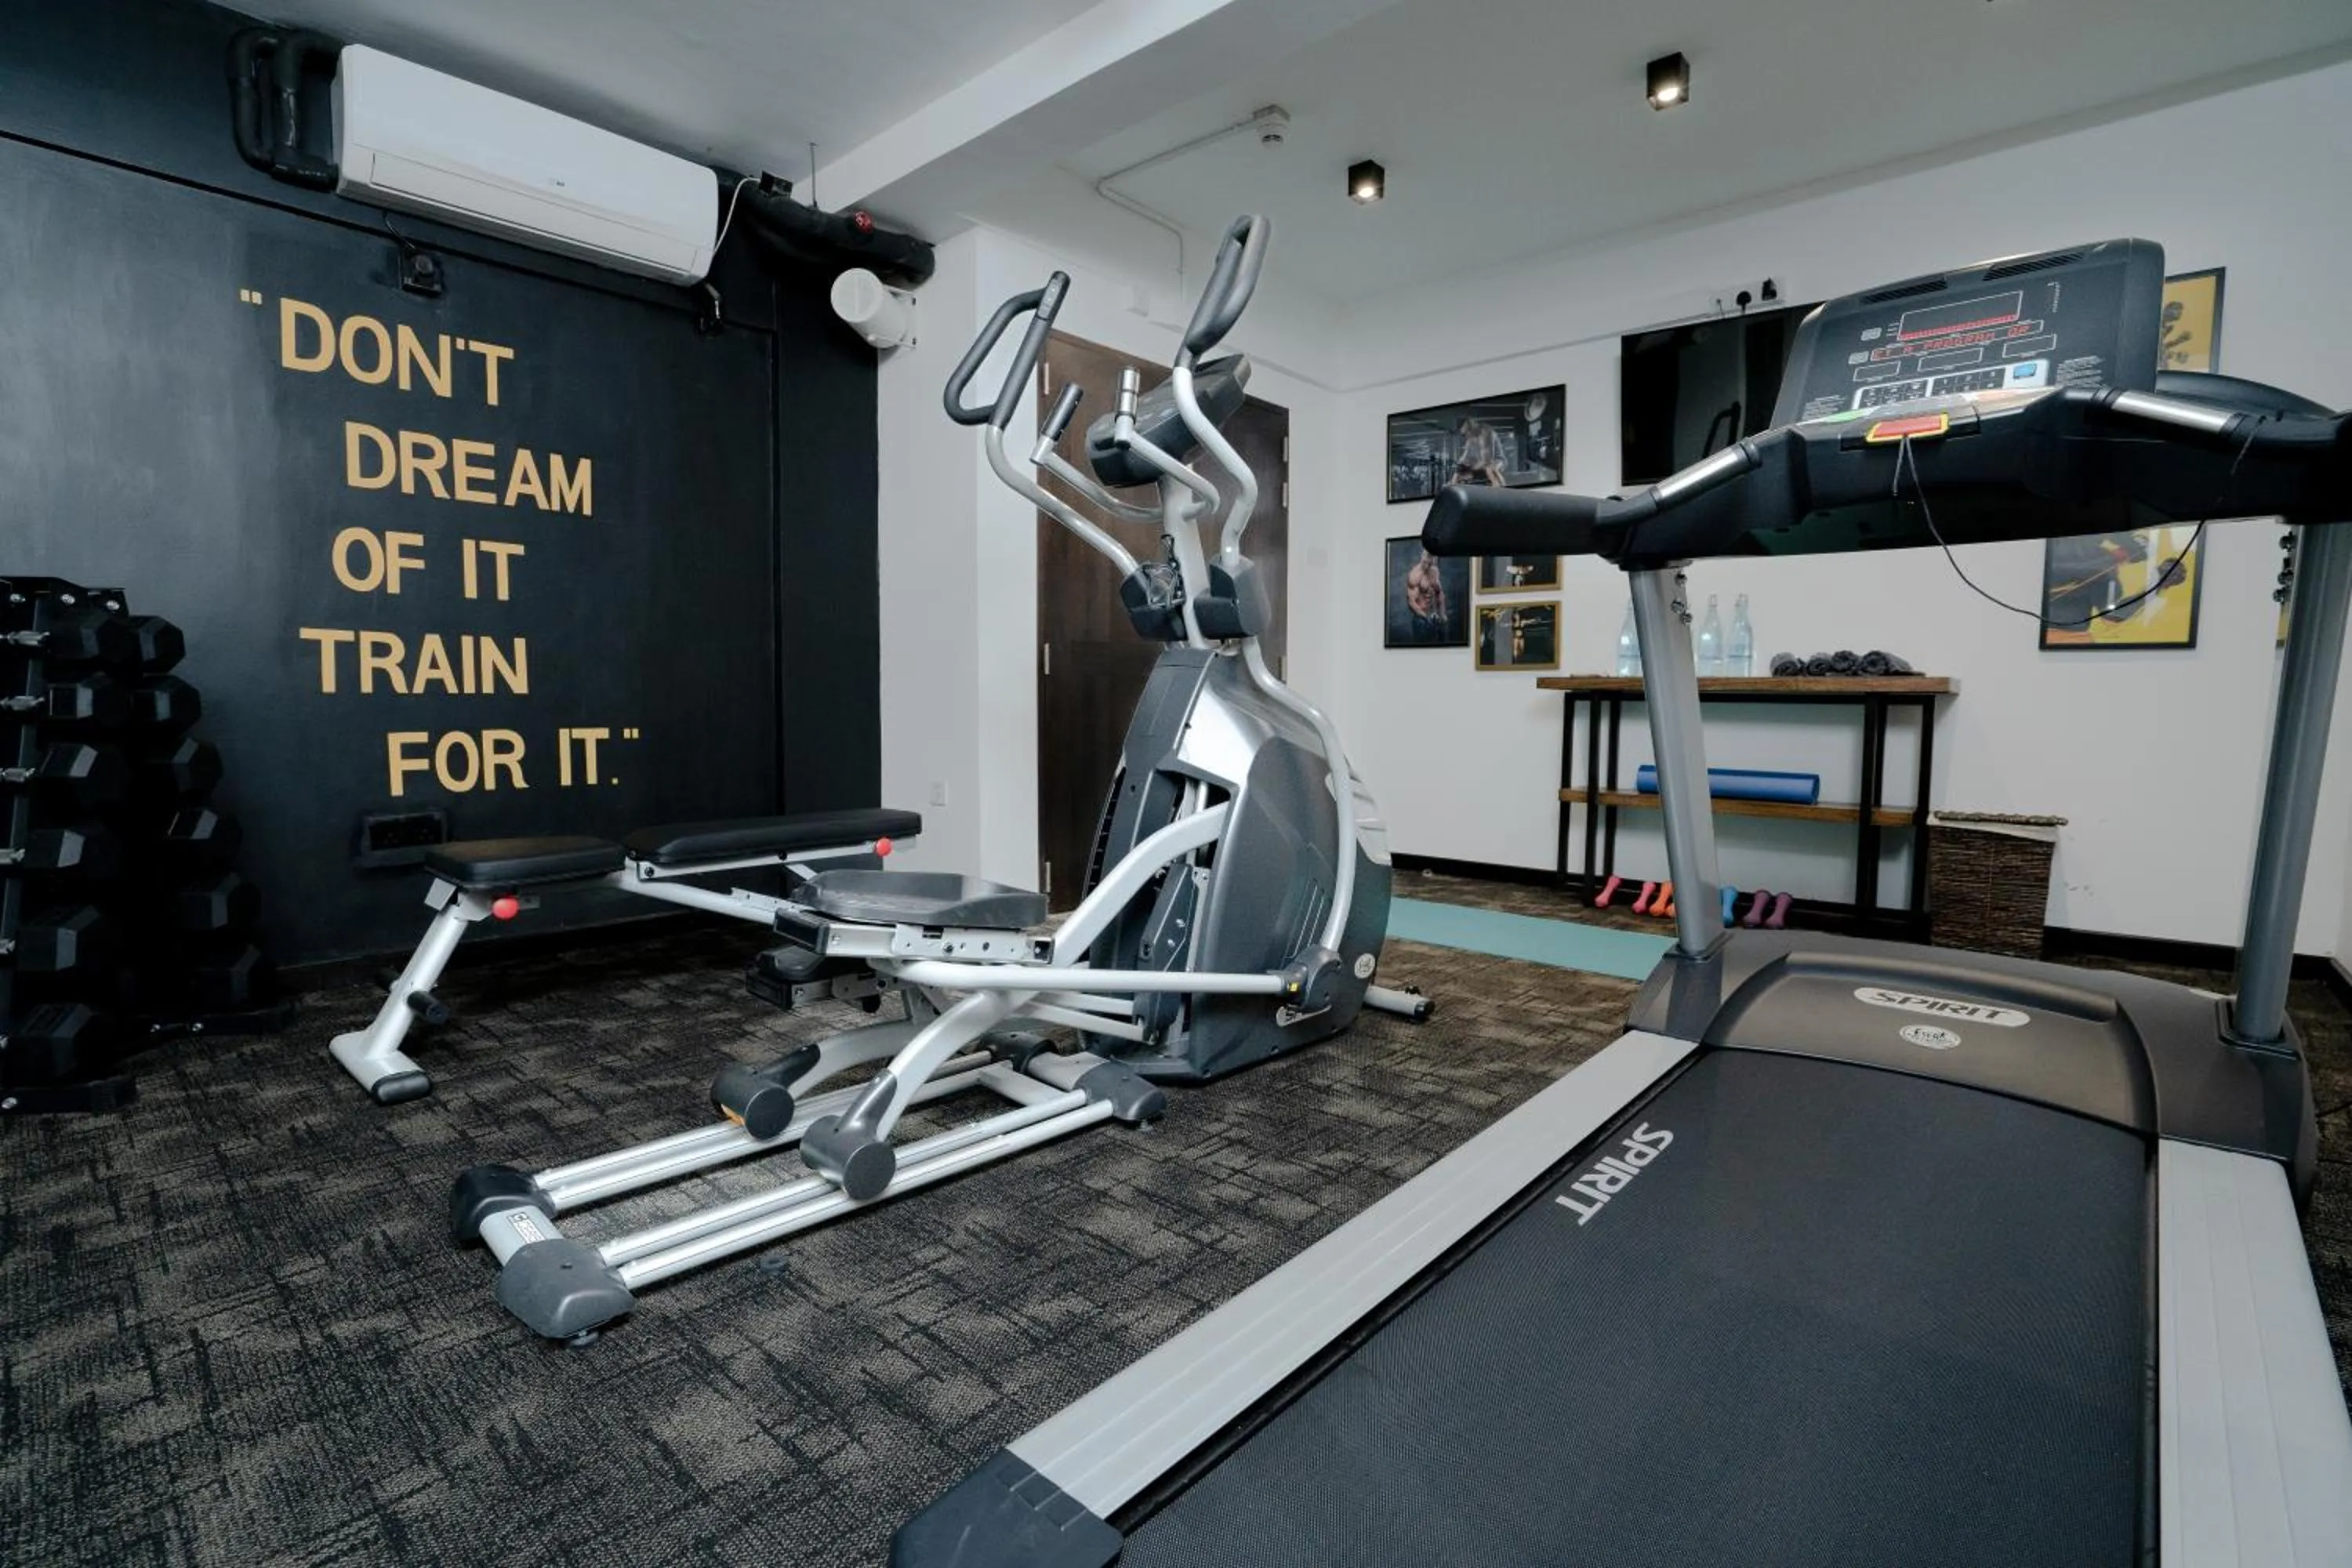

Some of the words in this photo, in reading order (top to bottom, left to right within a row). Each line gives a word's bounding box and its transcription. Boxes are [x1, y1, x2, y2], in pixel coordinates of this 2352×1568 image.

[345, 421, 593, 517] DREAM
[332, 526, 426, 594] OF
[463, 539, 524, 601] IT
[299, 627, 529, 694] TRAIN
[387, 728, 529, 797] FOR
[1869, 991, 2013, 1018] SPIRIT
[1555, 1122, 1675, 1227] SPIRIT
